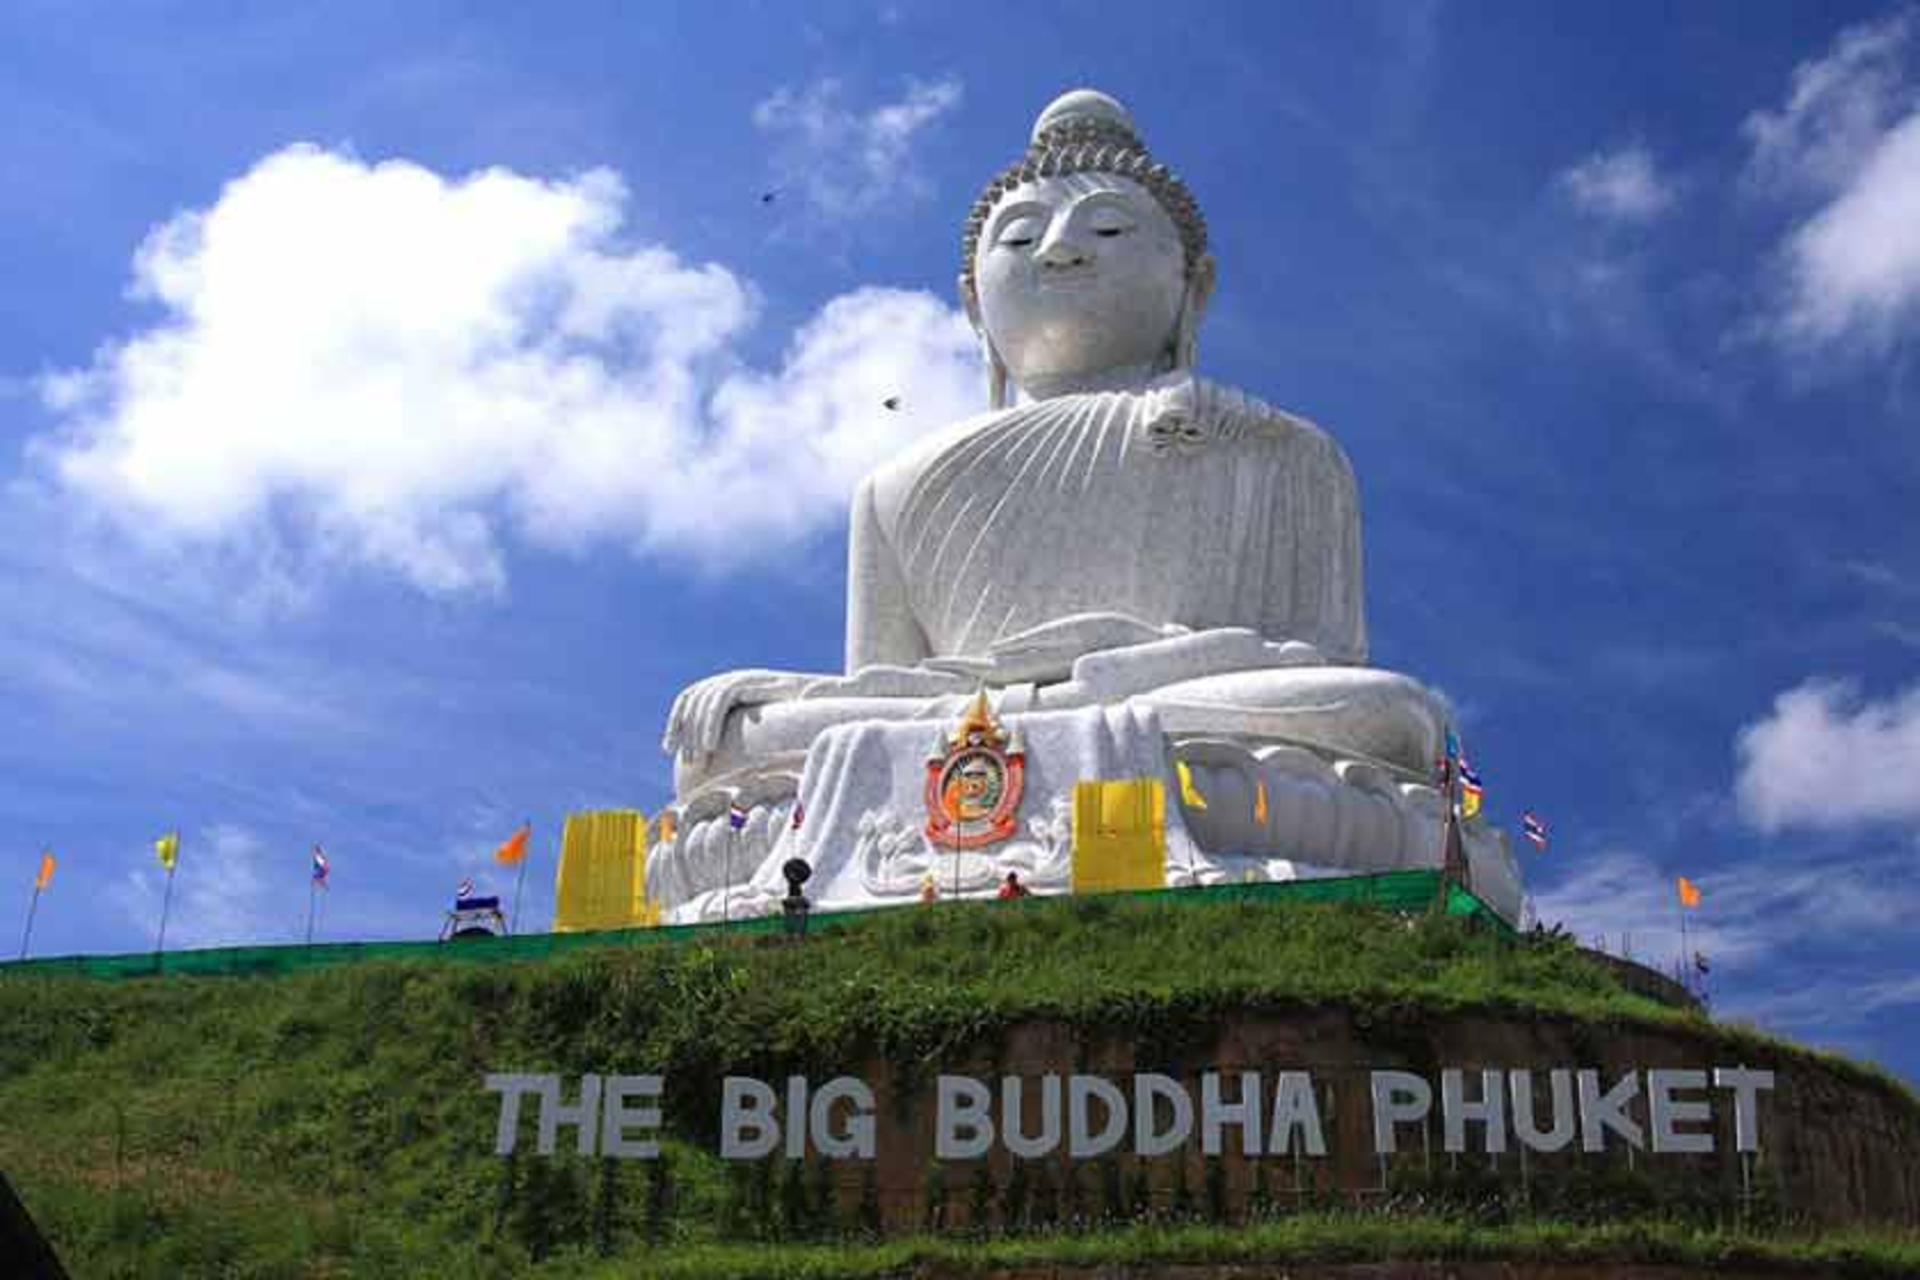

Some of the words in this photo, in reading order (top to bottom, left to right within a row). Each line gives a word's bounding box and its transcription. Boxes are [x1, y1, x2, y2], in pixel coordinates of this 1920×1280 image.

[485, 1073, 664, 1158] THE
[721, 1075, 876, 1159] BIG
[936, 1071, 1326, 1158] BUDDHA
[1371, 1066, 1774, 1153] PHUKET
